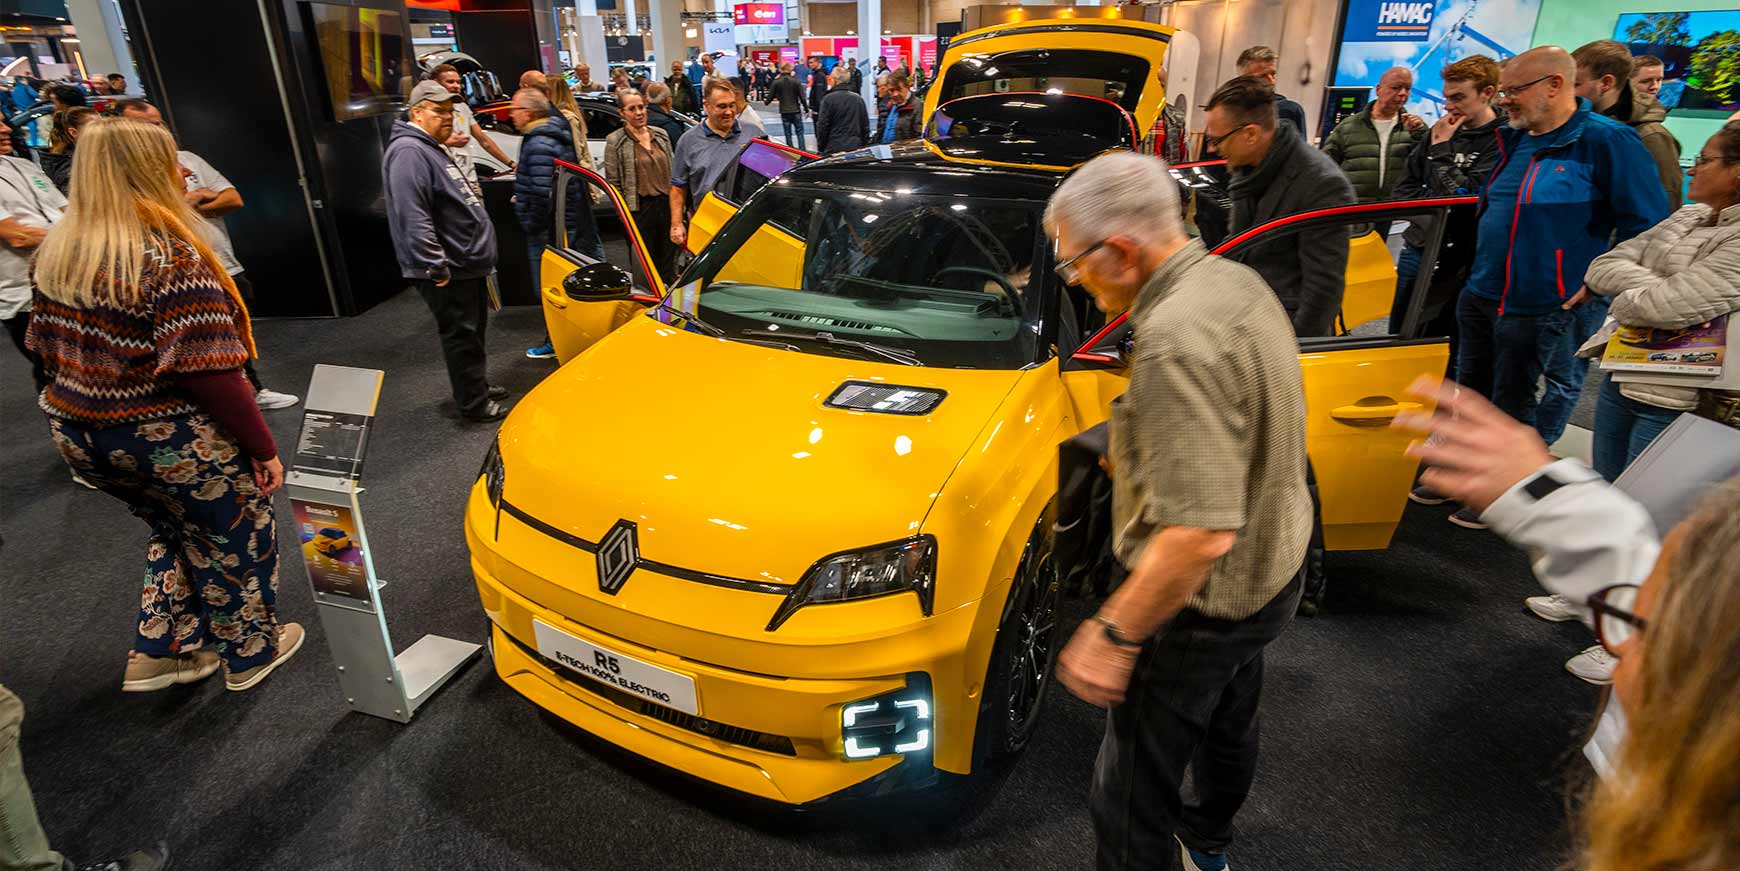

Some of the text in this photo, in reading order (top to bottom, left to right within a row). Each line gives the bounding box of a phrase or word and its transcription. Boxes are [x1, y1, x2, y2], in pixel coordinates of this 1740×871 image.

[1378, 2, 1434, 24] HAMAG
[593, 650, 620, 674] R5
[555, 651, 671, 703] E-TECH 100% ELECTRIC
